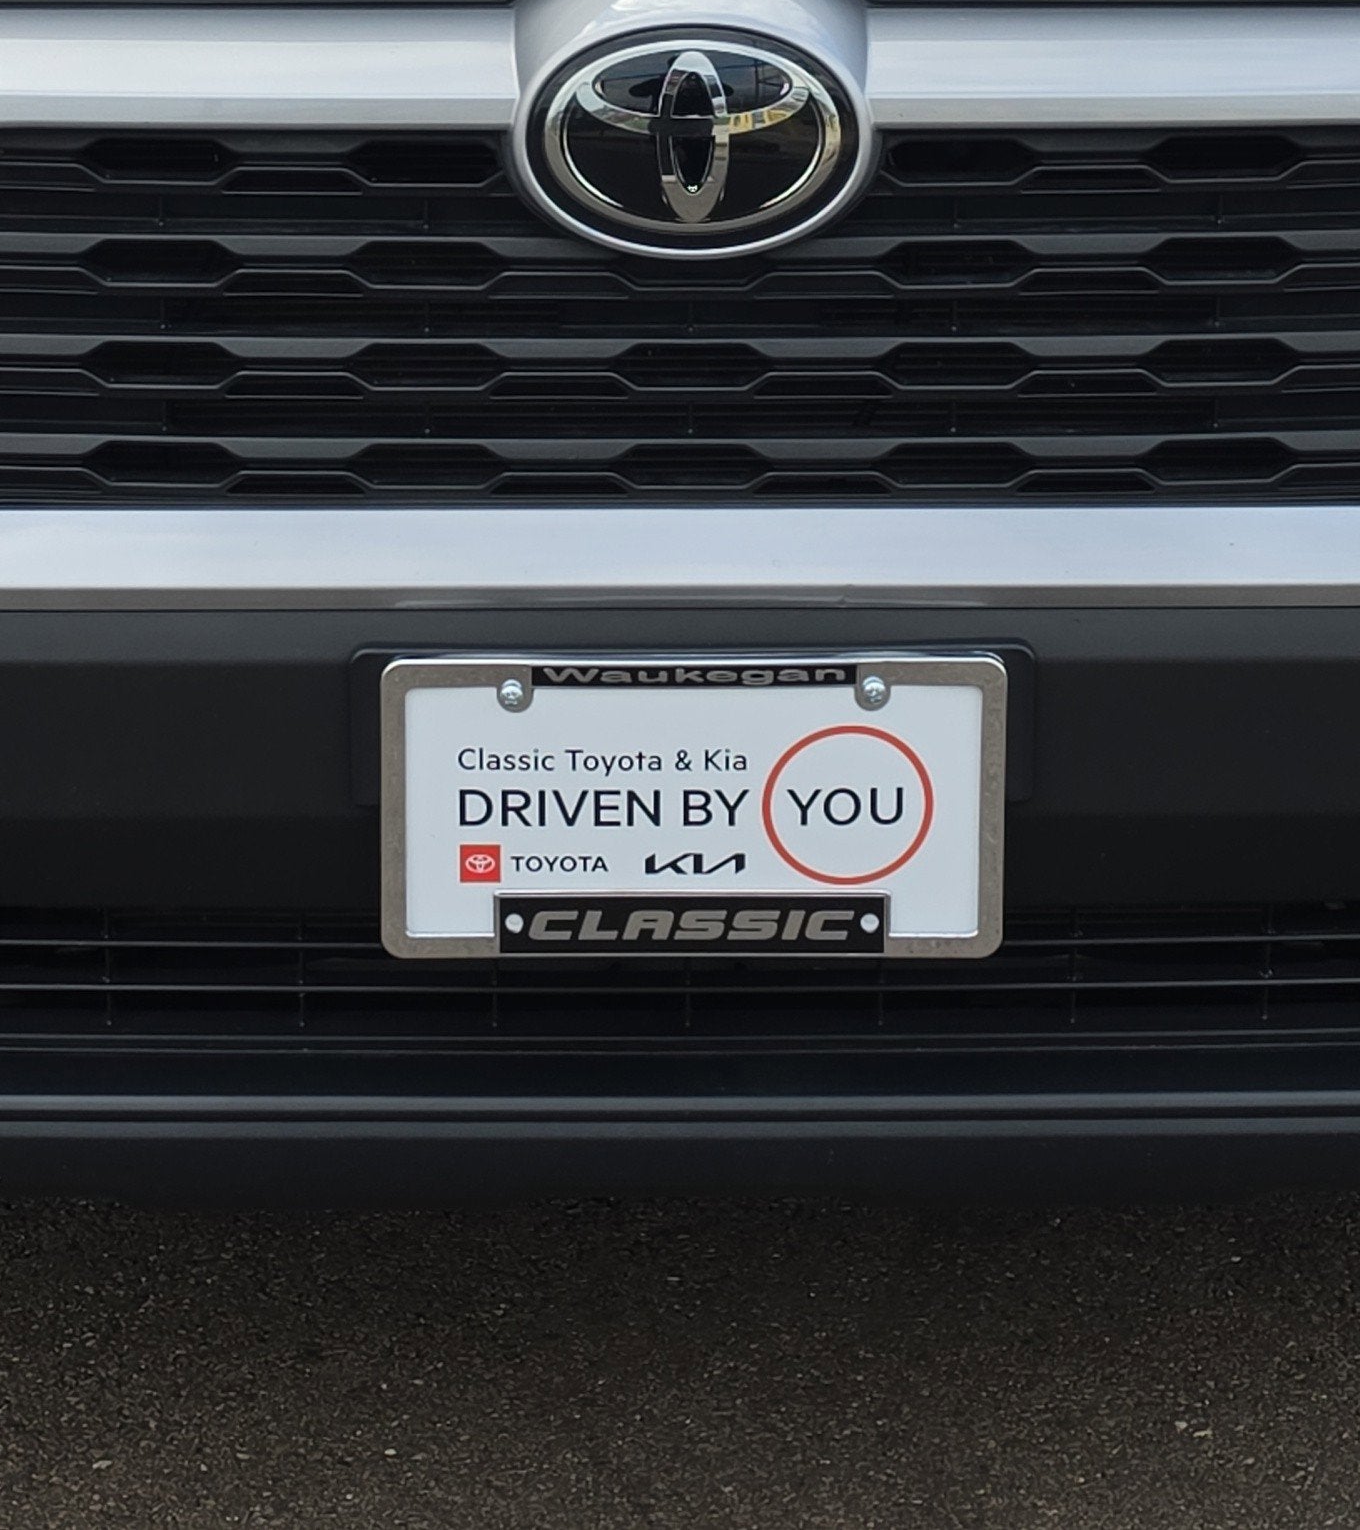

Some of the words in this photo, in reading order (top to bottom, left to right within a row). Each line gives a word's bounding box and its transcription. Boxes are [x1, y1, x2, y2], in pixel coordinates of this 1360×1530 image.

[543, 667, 846, 686] Waukegan
[457, 747, 555, 771] Classic
[565, 749, 662, 776] Toyota
[674, 749, 693, 771] &
[703, 748, 748, 771] Kia
[459, 788, 661, 827] DRIVEN
[682, 788, 750, 827] BY
[787, 786, 905, 826] YOU
[510, 855, 609, 873] TOYOTA
[528, 909, 855, 941] CLASSIC
